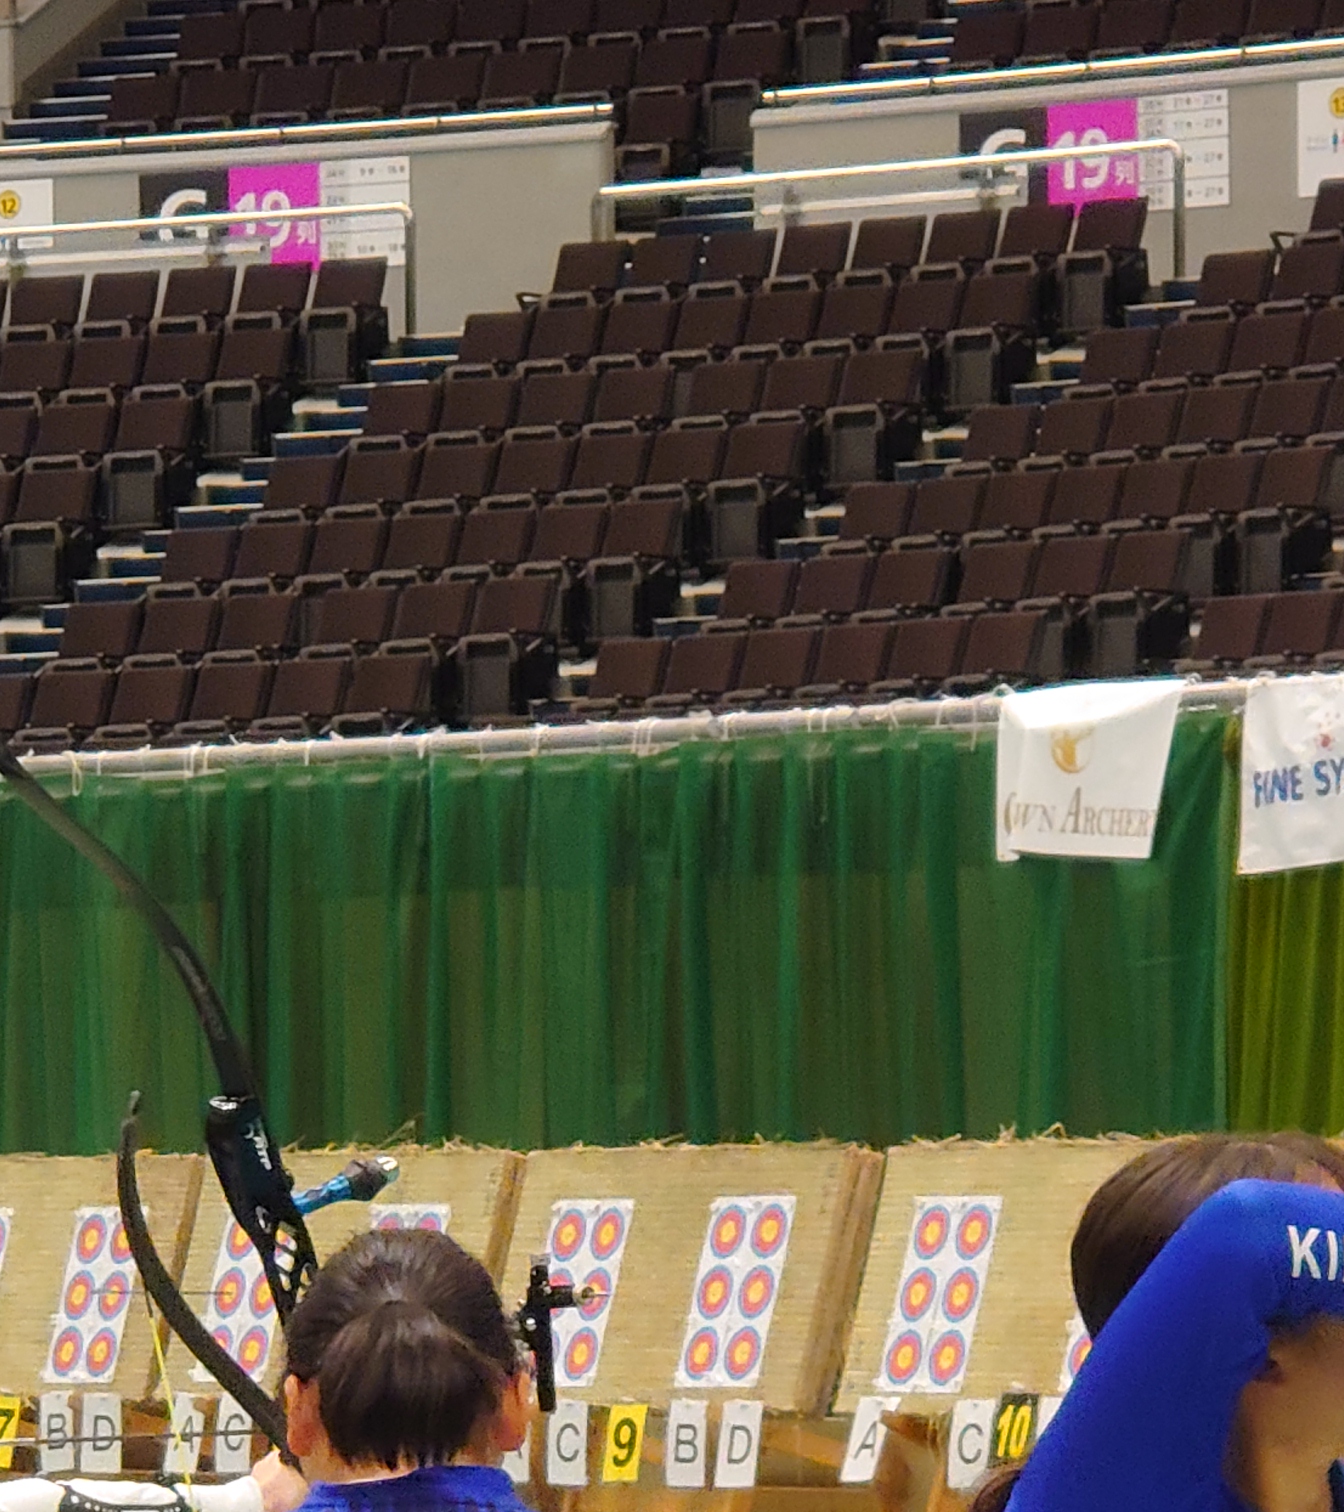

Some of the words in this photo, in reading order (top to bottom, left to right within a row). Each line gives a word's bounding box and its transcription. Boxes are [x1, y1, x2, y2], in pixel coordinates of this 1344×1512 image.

[0, 196, 17, 215] 12
[1060, 786, 1158, 837] ARCHER
[46, 1413, 67, 1451] B
[92, 1415, 115, 1452] D
[173, 1415, 194, 1453] A
[223, 1412, 246, 1451] C
[556, 1422, 580, 1463] C
[612, 1416, 638, 1468] 9
[673, 1423, 699, 1464] B
[726, 1424, 753, 1465] D
[853, 1420, 878, 1461] A
[957, 1422, 984, 1465] C
[997, 1403, 1032, 1459] 10
